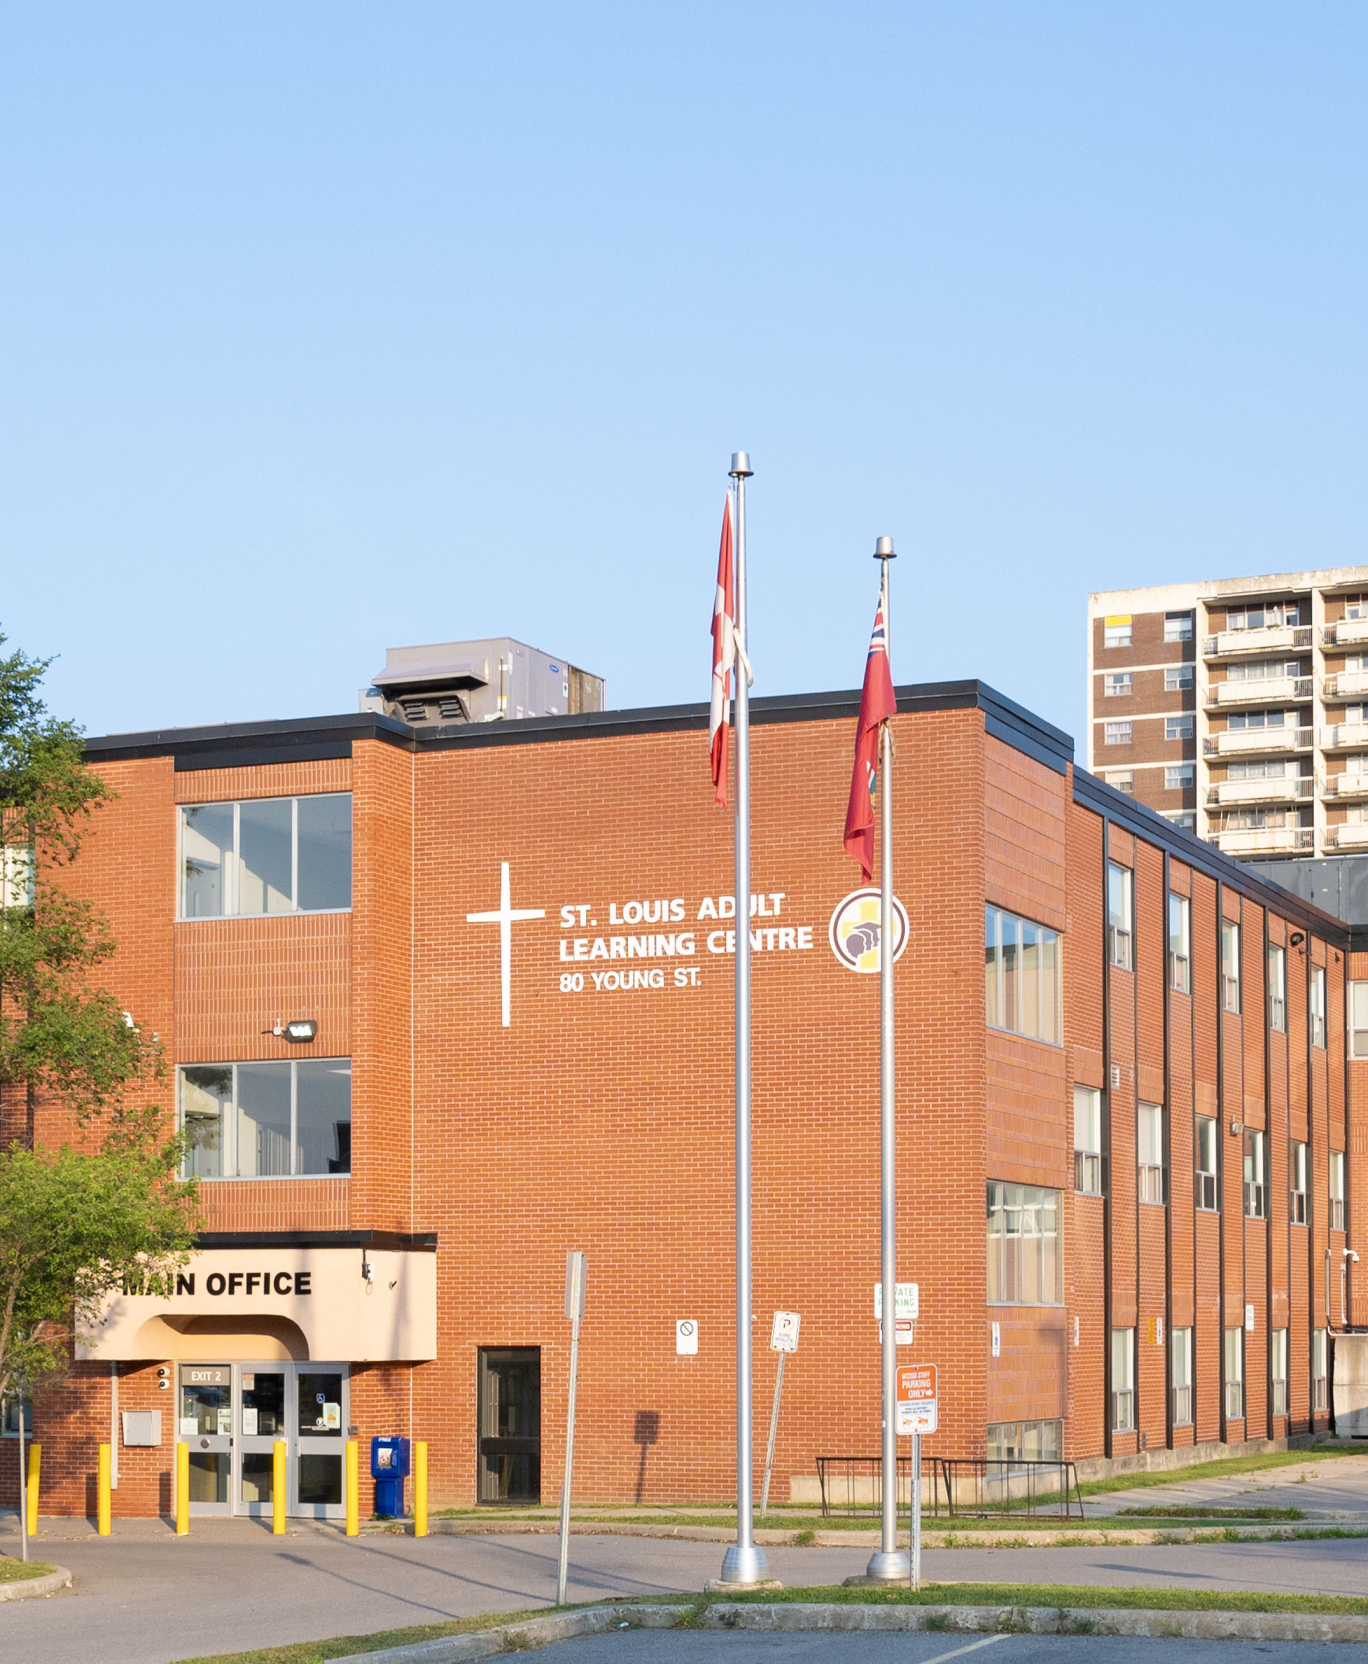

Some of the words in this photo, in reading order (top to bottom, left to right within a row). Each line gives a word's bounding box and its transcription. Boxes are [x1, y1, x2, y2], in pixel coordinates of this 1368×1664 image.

[560, 904, 598, 928] ST.
[609, 898, 685, 925] LOUIS
[559, 932, 696, 962] LEARNING
[706, 926, 814, 954] CENTRE
[559, 972, 584, 993] 80
[591, 968, 665, 991] YOUNG
[673, 967, 702, 988] ST.
[122, 1272, 195, 1296] MIN
[205, 1271, 312, 1296] OFFICE
[878, 1287, 914, 1297] PATE
[878, 1298, 915, 1307] PKING
[191, 1371, 212, 1381] EXIT
[215, 1371, 221, 1381] 2
[901, 1379, 931, 1389] PARKING
[908, 1388, 926, 1398] ONLY
